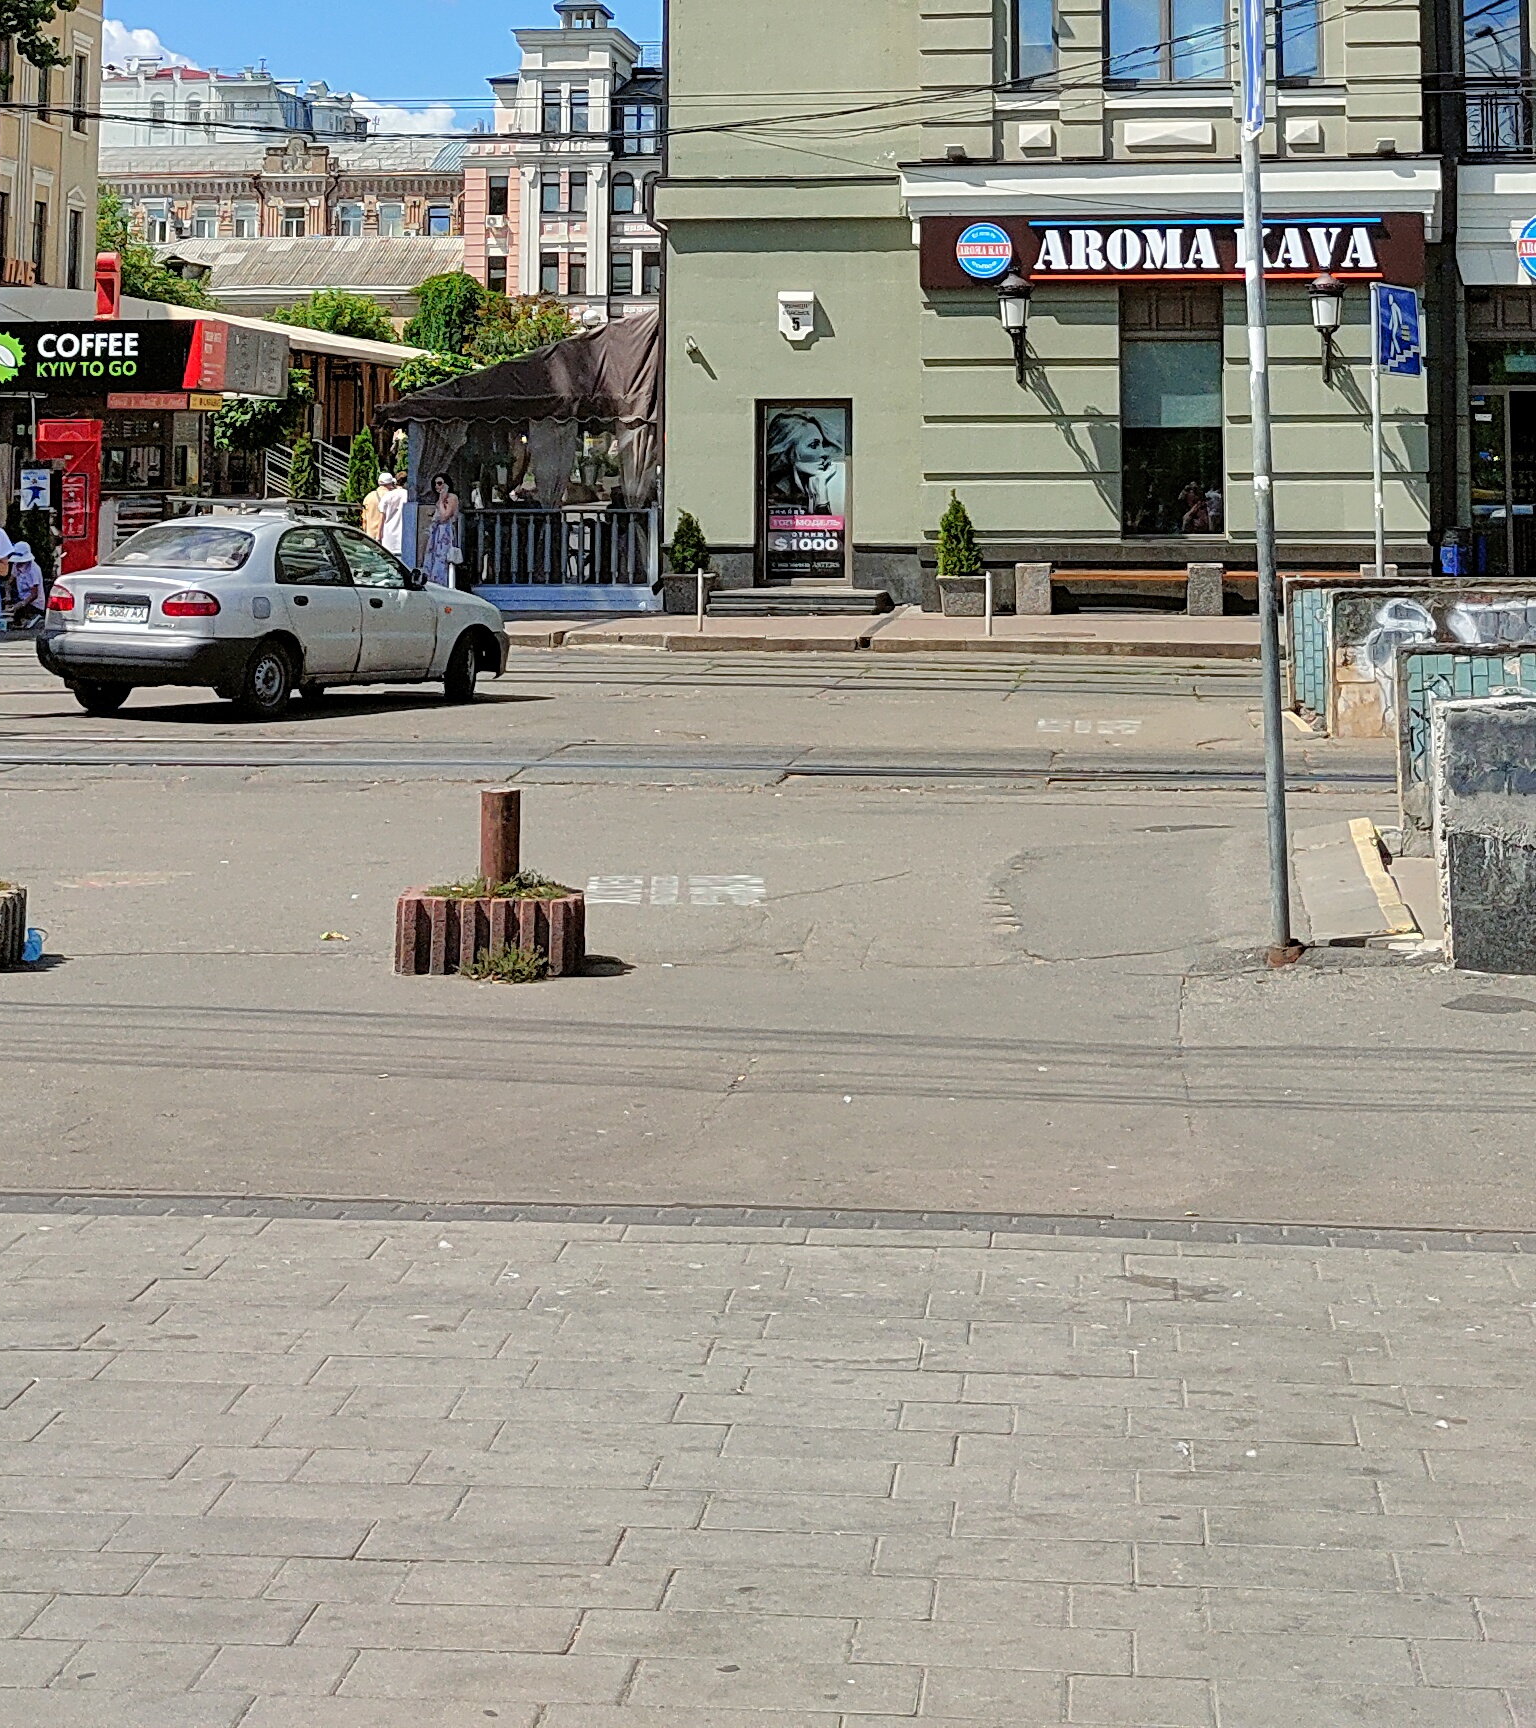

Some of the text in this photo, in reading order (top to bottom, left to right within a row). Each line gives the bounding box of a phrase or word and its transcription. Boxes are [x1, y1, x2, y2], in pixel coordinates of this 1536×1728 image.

[1033, 227, 1379, 271] AROMA KAVA
[5, 258, 36, 287] ПАБ
[791, 317, 801, 332] 5
[37, 333, 139, 358] COFFEE
[37, 361, 137, 377] KYIV TO GO
[774, 537, 839, 552] $1000
